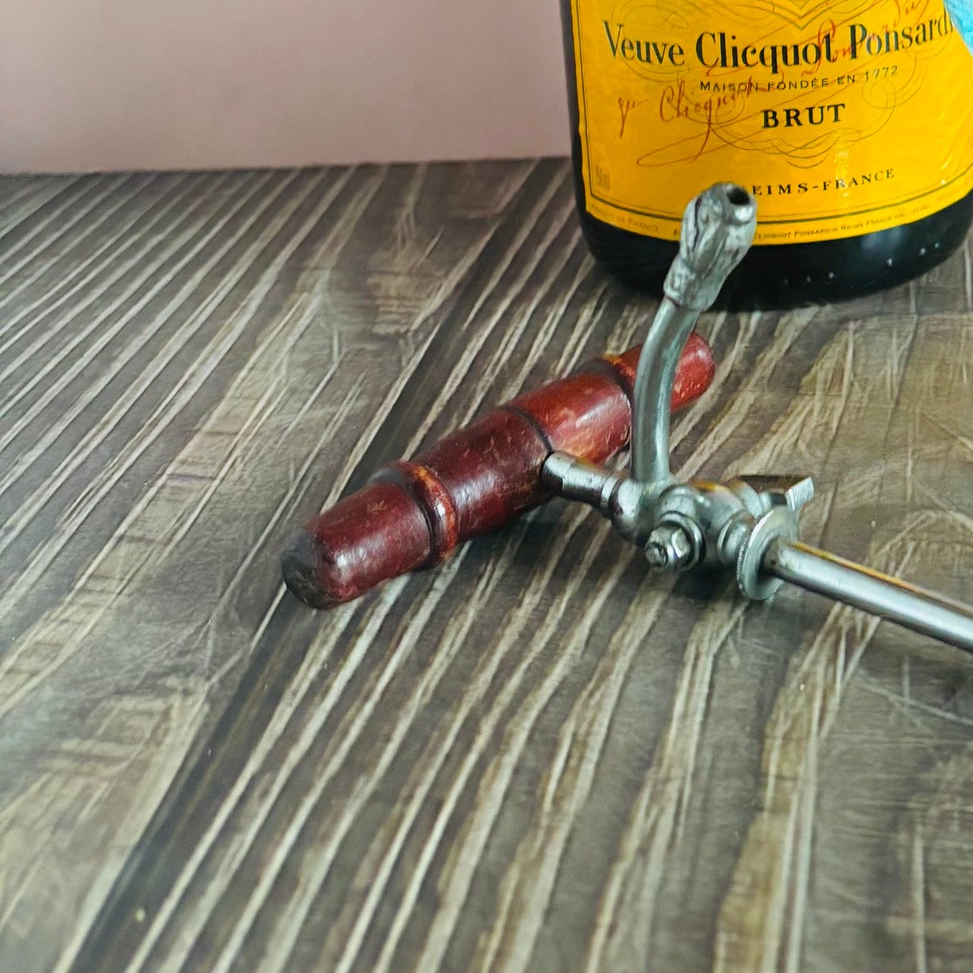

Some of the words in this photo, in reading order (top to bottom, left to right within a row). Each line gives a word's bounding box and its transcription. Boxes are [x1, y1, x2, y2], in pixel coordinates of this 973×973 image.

[603, 20, 685, 67] Veuve
[696, 31, 832, 74] Clicquot
[849, 5, 954, 60] Ponsard
[700, 80, 760, 93] MAISON
[766, 77, 830, 91] FONDÉE
[836, 74, 856, 85] EN
[864, 65, 899, 81] 1772
[761, 103, 846, 129] BRUT
[752, 167, 896, 197] EIMS-FRANCE
